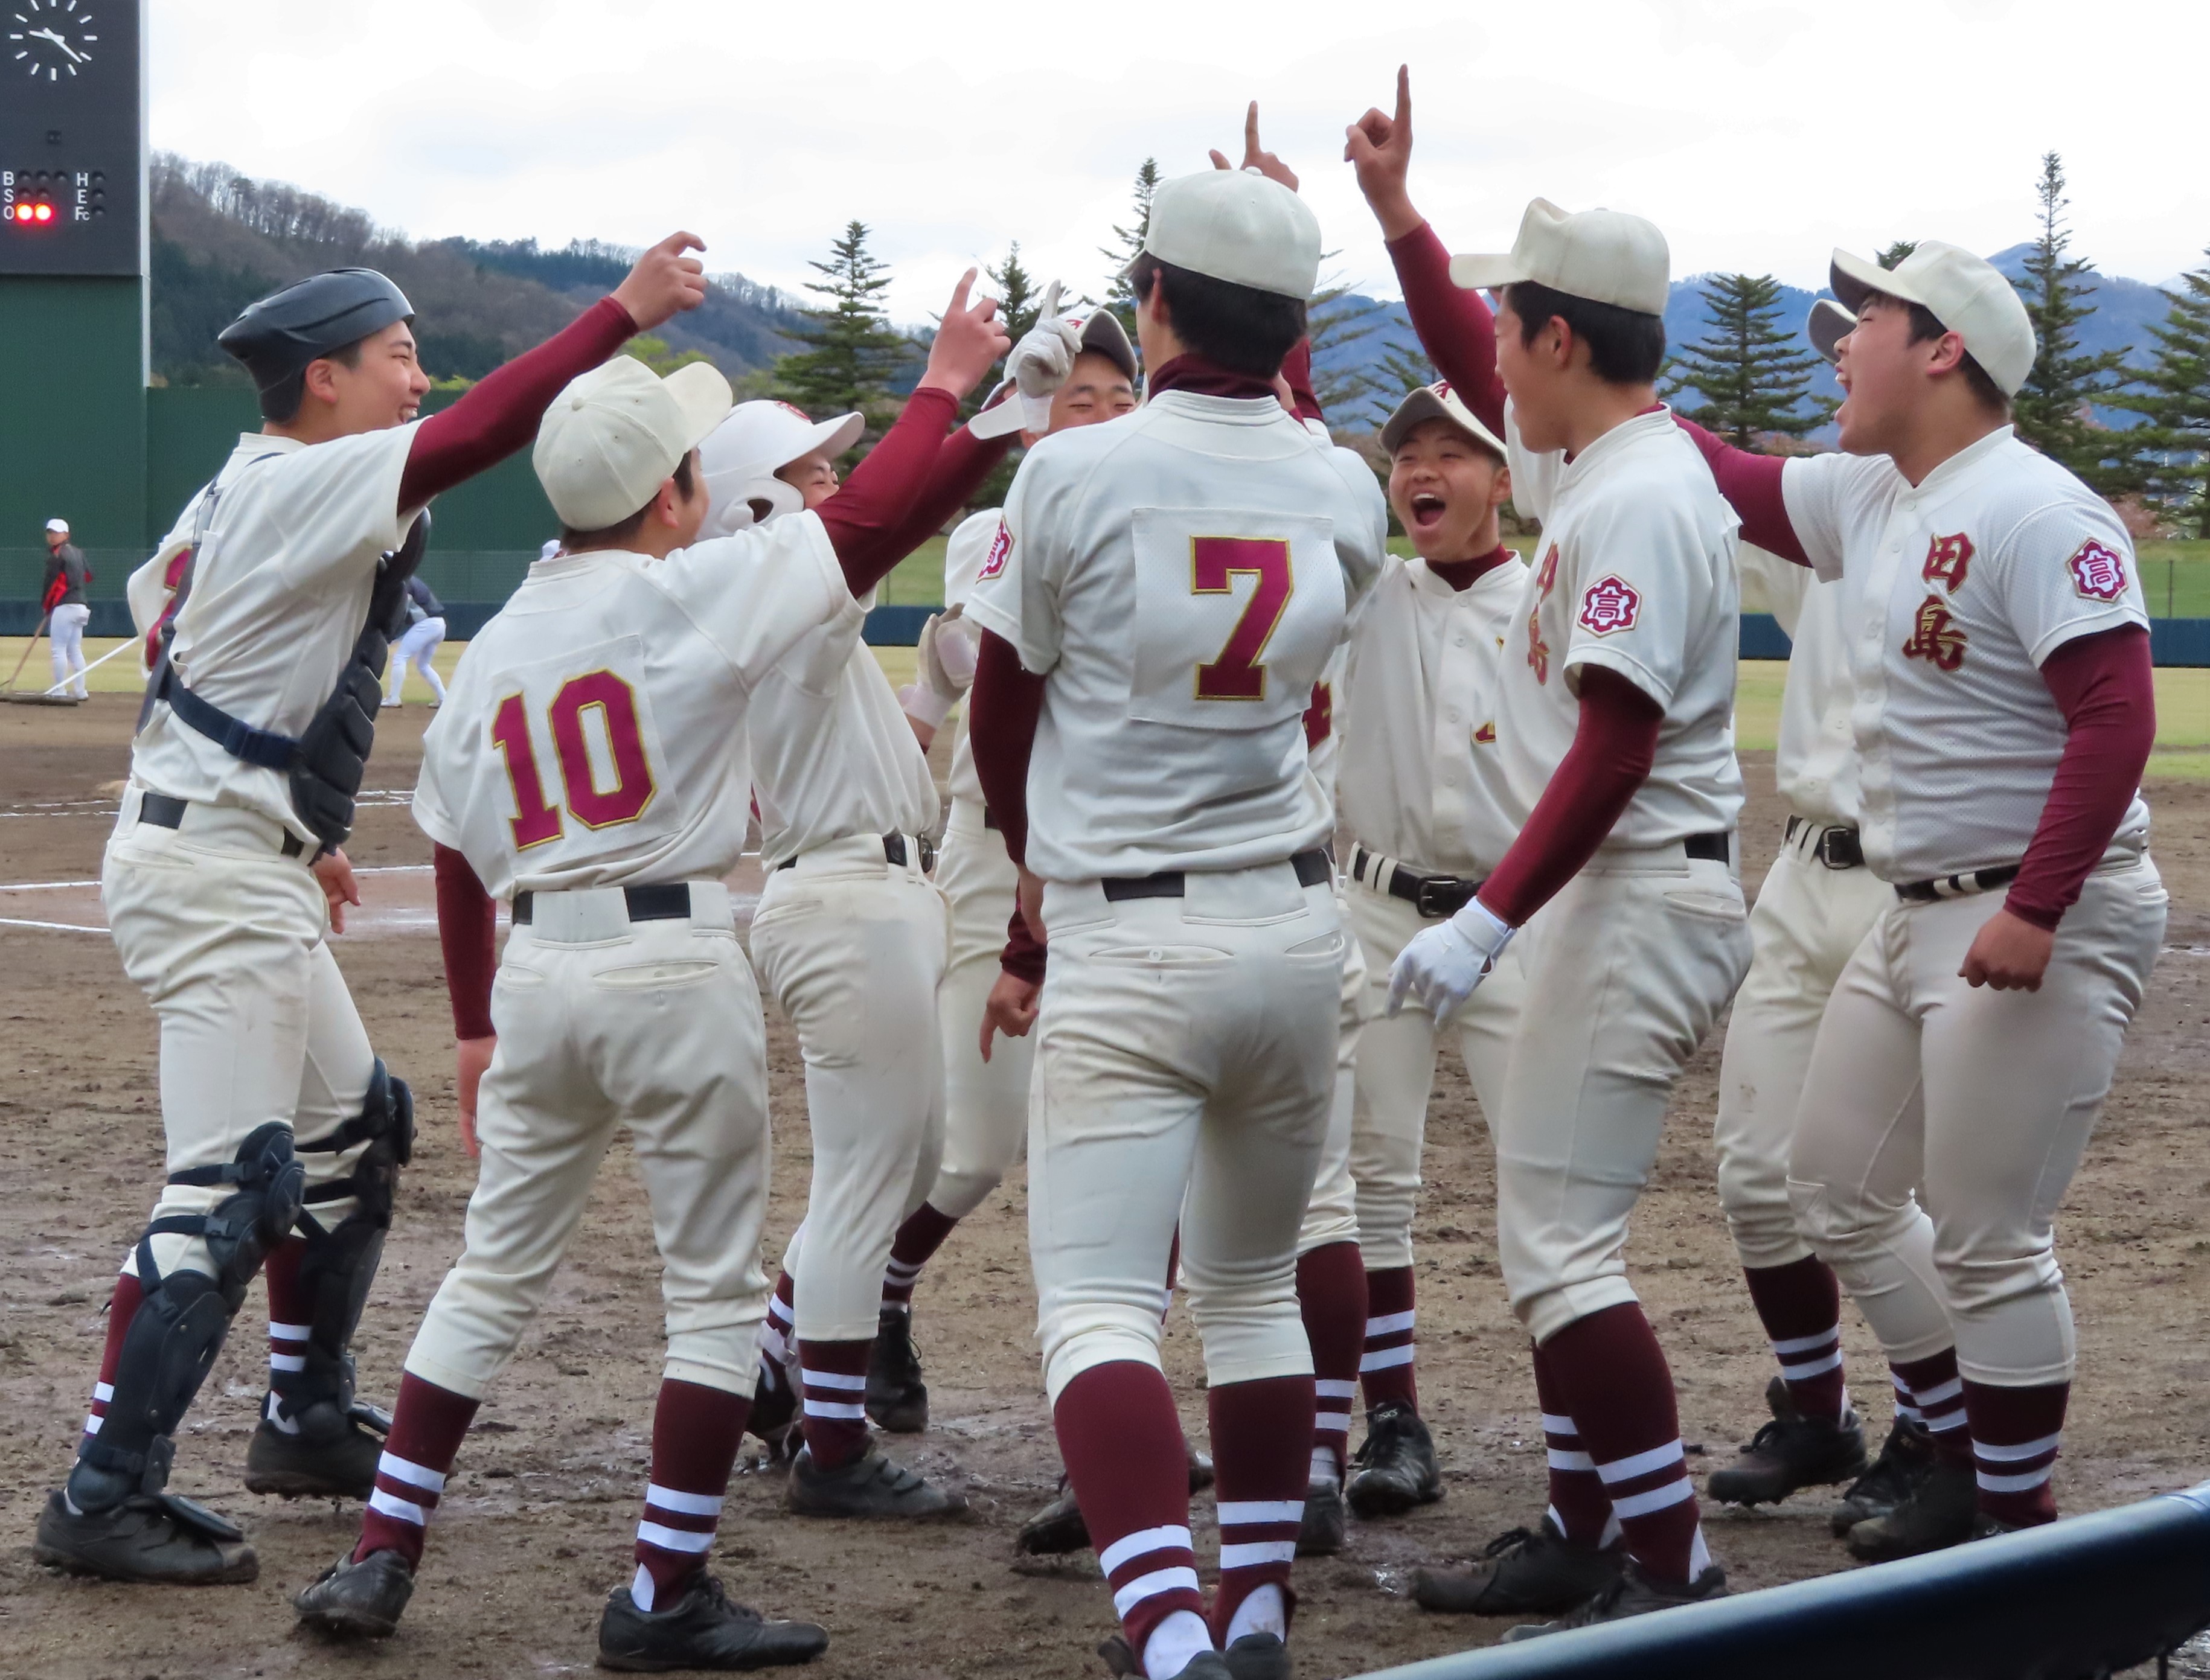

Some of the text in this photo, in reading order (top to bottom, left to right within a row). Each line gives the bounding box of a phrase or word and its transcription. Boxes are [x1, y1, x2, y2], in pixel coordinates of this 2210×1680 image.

[3, 171, 15, 187] B
[76, 172, 89, 187] H
[4, 188, 14, 203] S
[77, 189, 88, 204] E
[2084, 555, 2117, 586] 高
[1592, 590, 1623, 619] 高
[1189, 534, 1294, 701] 7
[490, 668, 658, 852] 10
